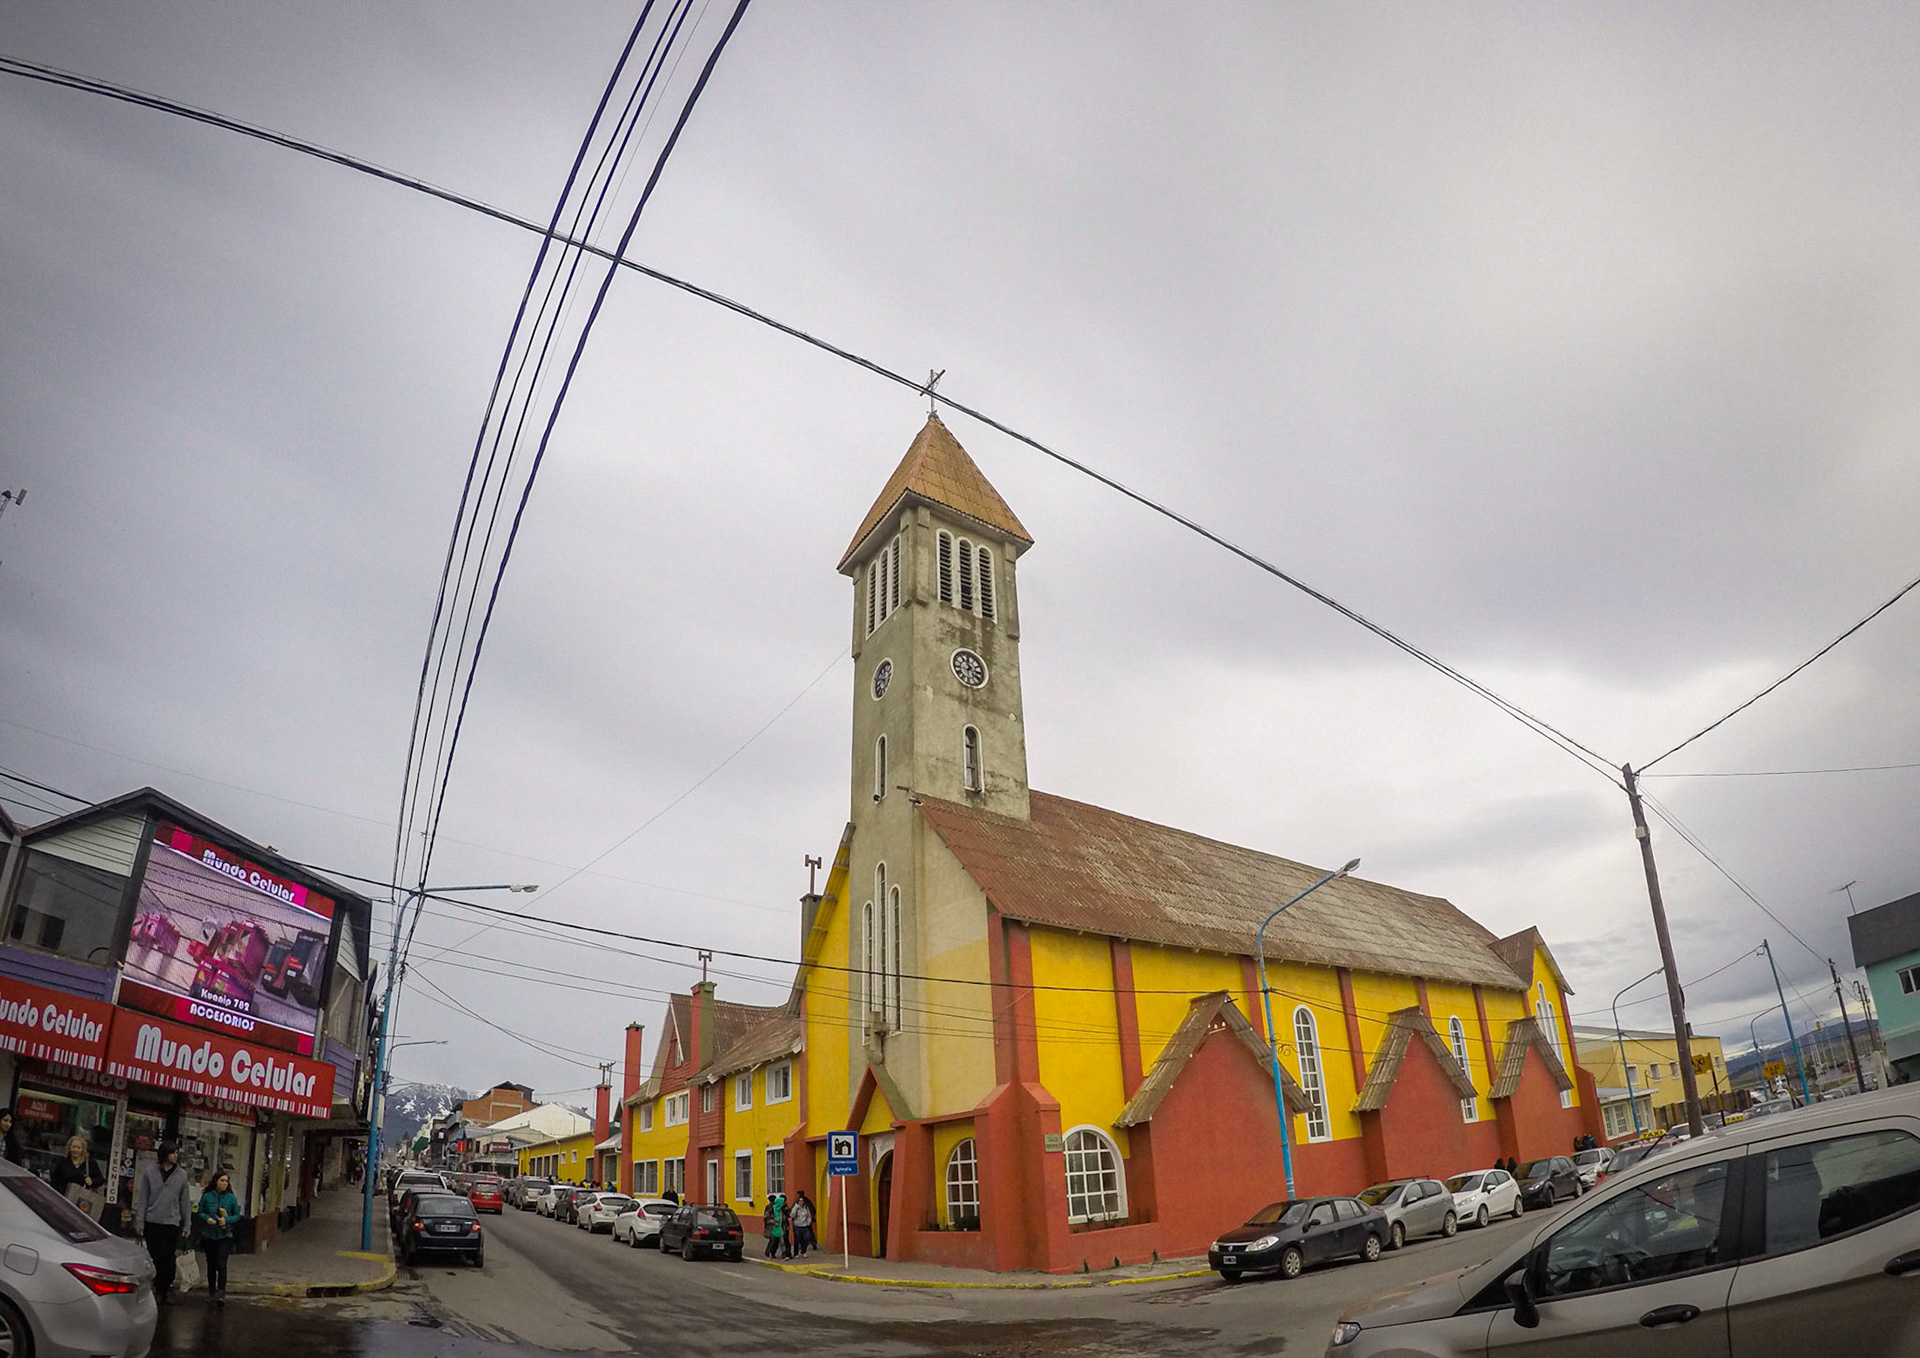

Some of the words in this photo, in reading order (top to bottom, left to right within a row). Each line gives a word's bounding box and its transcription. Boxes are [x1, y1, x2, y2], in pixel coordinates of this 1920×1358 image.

[202, 849, 247, 880] Mundo
[250, 871, 295, 902] Celular
[190, 1003, 255, 1031] ACCESORIOS
[233, 998, 250, 1012] 782
[0, 999, 39, 1028] undo
[42, 1004, 103, 1043] Celular
[134, 1024, 225, 1078] Mundo
[231, 1049, 316, 1098] Celular
[1765, 1062, 1782, 1073] TAXI
[1726, 1115, 1744, 1124] TAXI
[1643, 1130, 1664, 1139] TAXI
[109, 1151, 119, 1202] TECNICO
